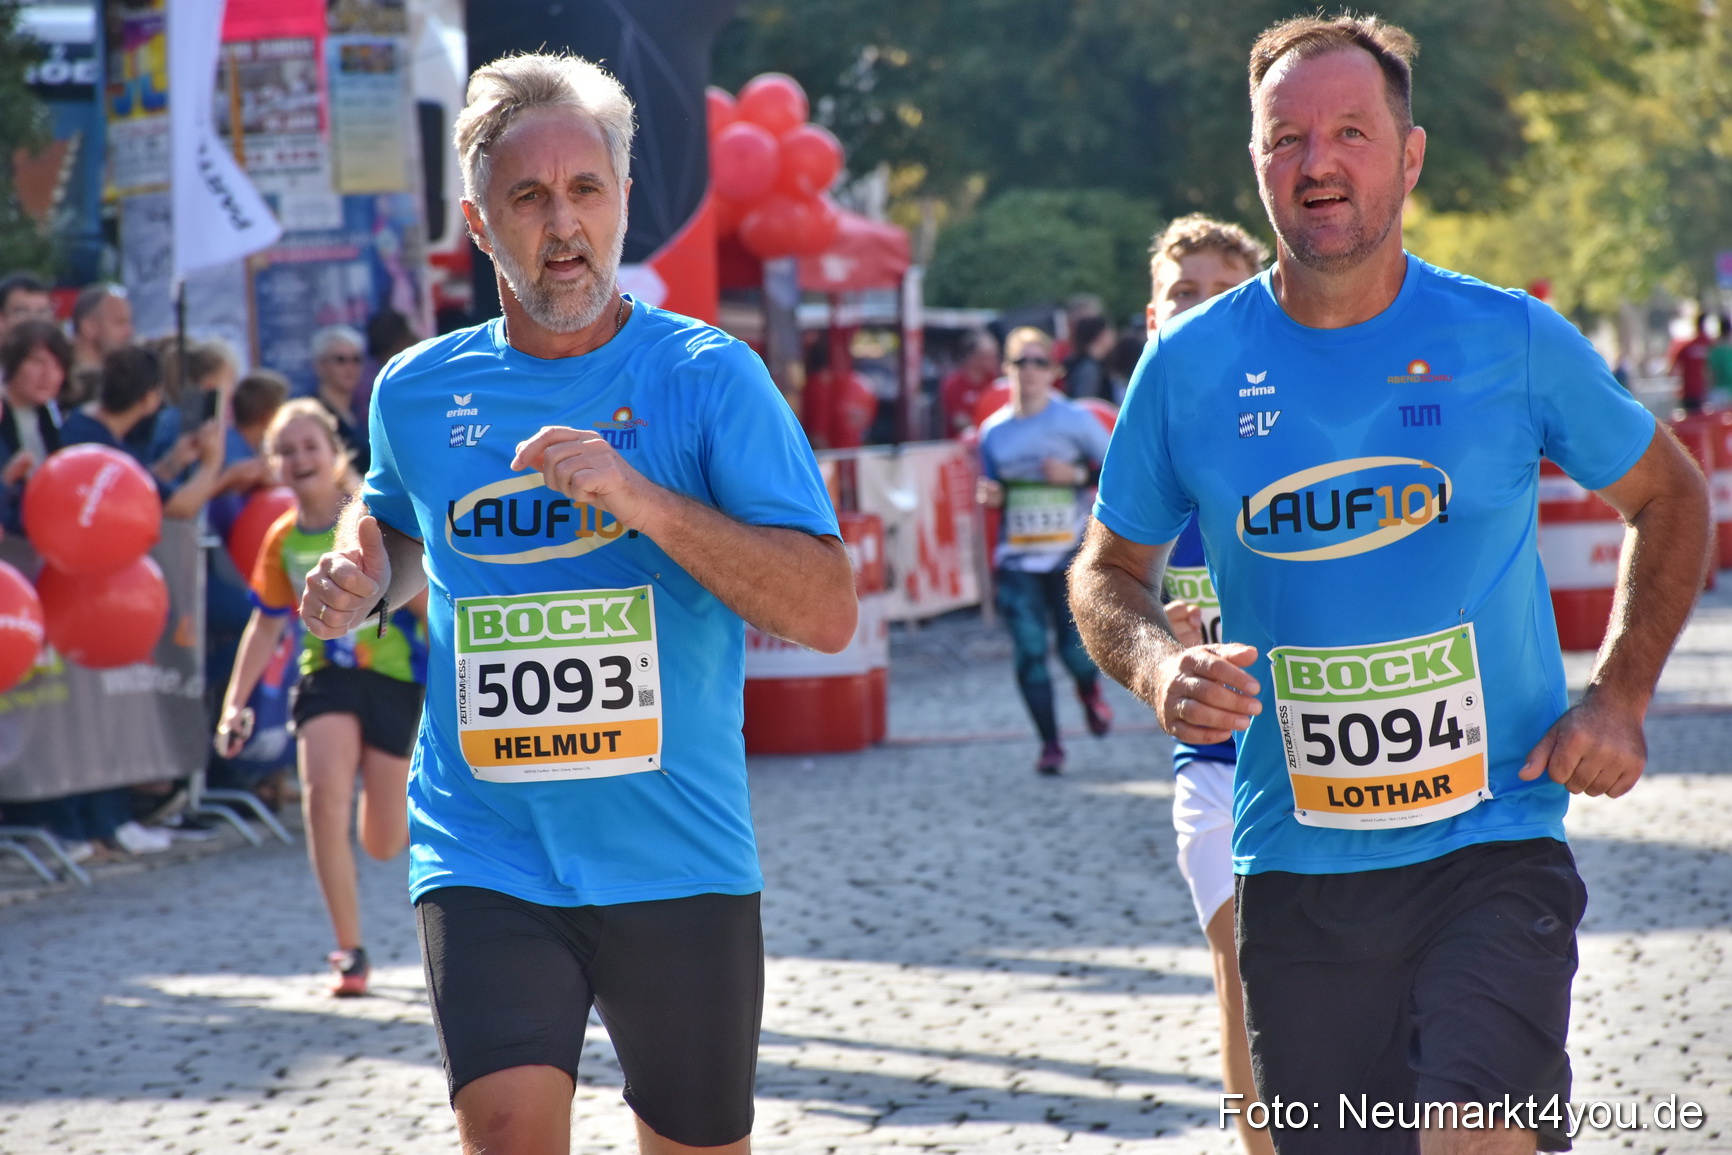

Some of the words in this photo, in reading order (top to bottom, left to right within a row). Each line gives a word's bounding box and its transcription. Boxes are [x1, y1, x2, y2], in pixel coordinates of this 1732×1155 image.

[1239, 385, 1276, 397] erima
[446, 407, 478, 418] erima
[1238, 409, 1283, 438] BLV
[1399, 404, 1442, 428] TUM
[449, 424, 492, 448] BLV
[600, 429, 637, 449] TUM
[447, 498, 639, 539] LAUF10
[1242, 483, 1449, 536] LAUF10!
[468, 596, 638, 646] BOCK
[640, 657, 649, 668] S
[1285, 637, 1463, 695] BOCK
[478, 655, 634, 718] 5093
[1465, 696, 1474, 706] S
[494, 730, 622, 760] HELMUT
[1301, 699, 1464, 767] 5094
[1326, 774, 1453, 807] LOTHAR
